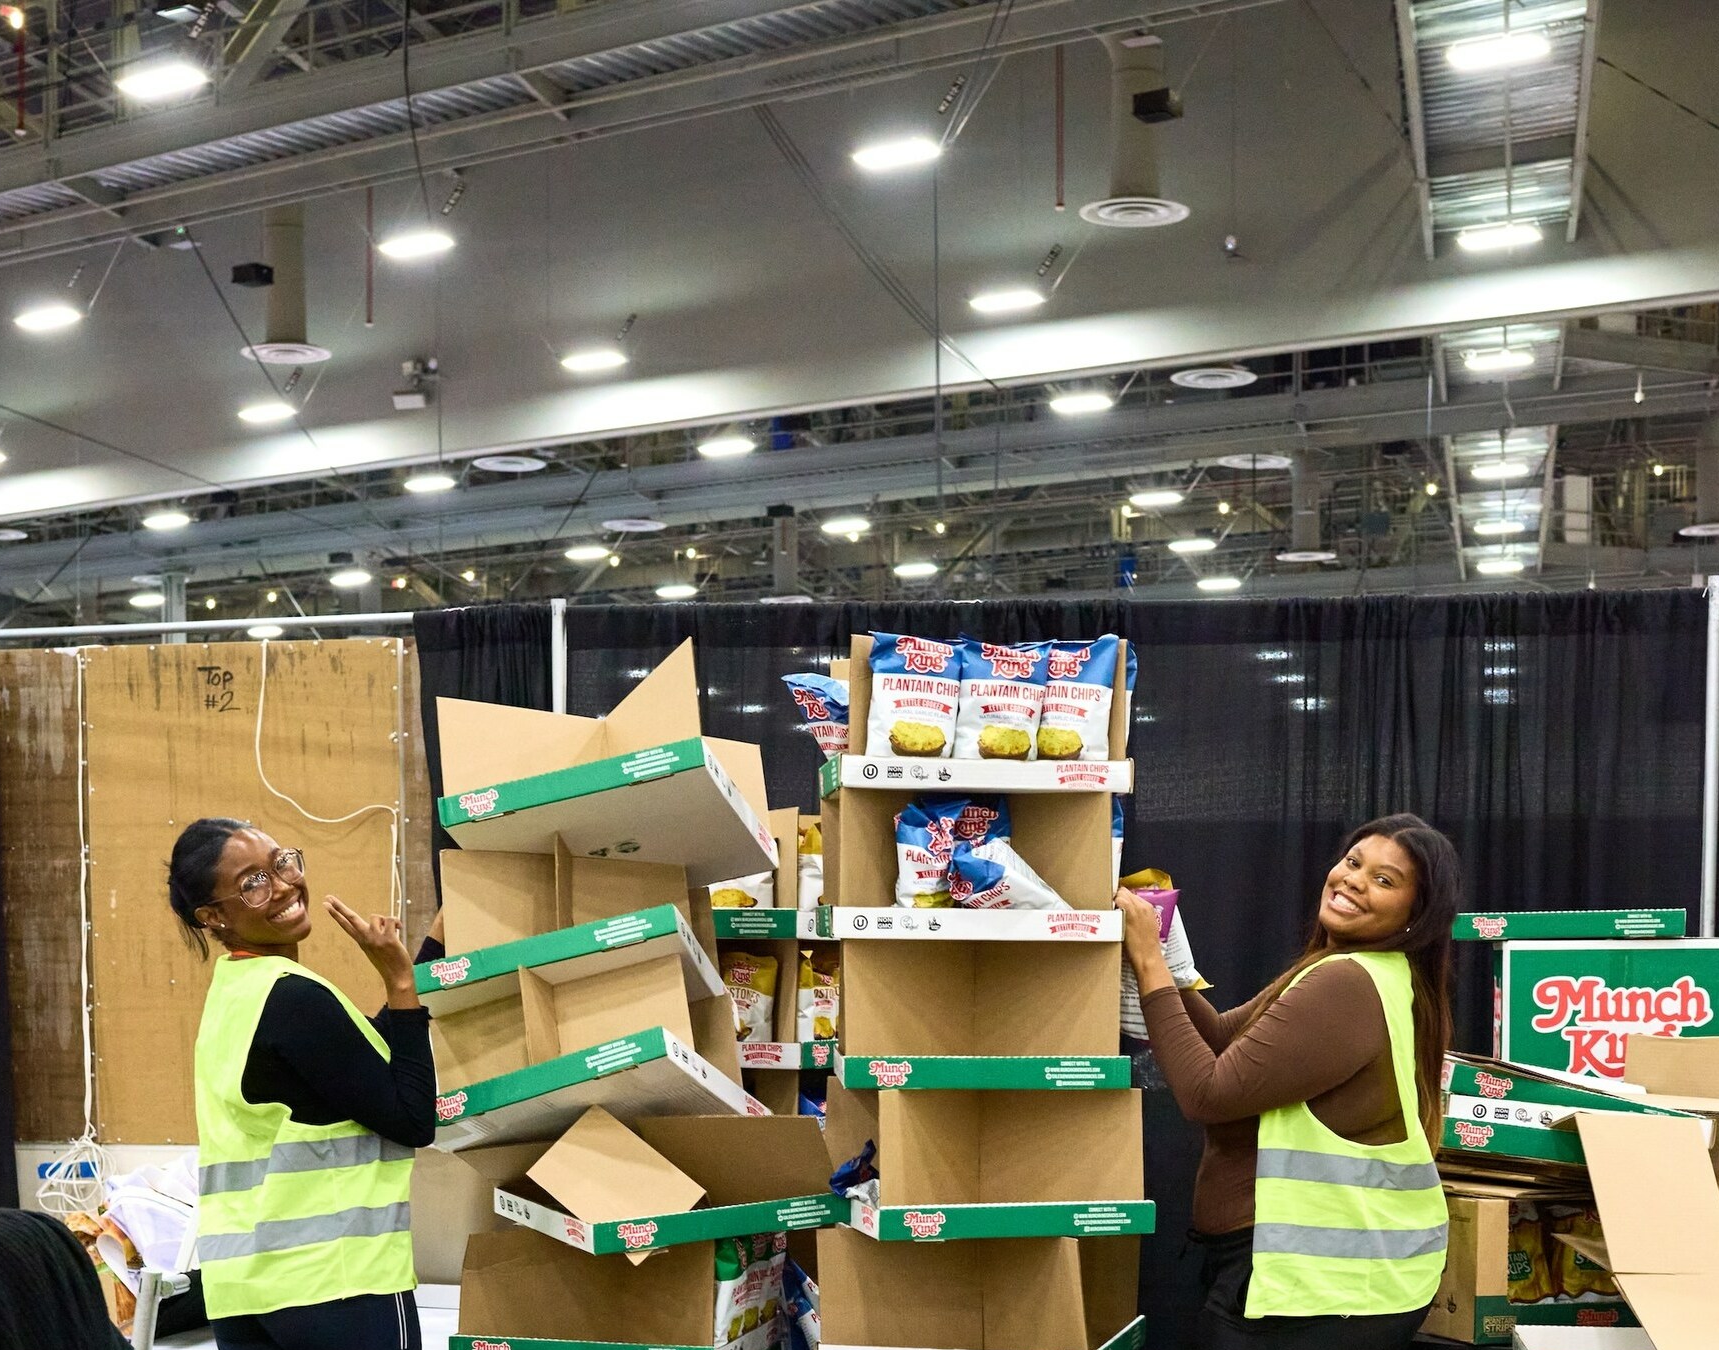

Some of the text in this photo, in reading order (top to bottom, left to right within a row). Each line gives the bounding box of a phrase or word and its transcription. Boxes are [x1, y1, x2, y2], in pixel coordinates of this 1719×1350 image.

[897, 637, 953, 657] Munch
[906, 652, 943, 673] King
[993, 658, 1032, 678] King
[883, 678, 960, 697] PLANTAIN CHIP
[971, 686, 1021, 699] PLANTAIN
[1073, 688, 1101, 702] CHIPS
[901, 698, 944, 712] KETTLE COOKED
[988, 704, 1031, 716] KETTLE COOKED
[1056, 764, 1109, 774] PLANTAIN CHIPS
[460, 790, 498, 807] Munch
[468, 800, 492, 815] King
[983, 882, 1010, 903] CHIPS
[1047, 914, 1101, 924] PLANTAIN CHIPS
[1472, 917, 1507, 929] Munch
[1479, 925, 1502, 937] King
[432, 958, 470, 975] Munch
[440, 969, 466, 984] King
[1534, 980, 1710, 1028] Munch
[870, 1062, 912, 1076] Munch
[878, 1072, 907, 1087] King
[1475, 1072, 1512, 1089] Munch
[1479, 1082, 1505, 1098] King
[439, 1102, 462, 1120] King
[1455, 1122, 1493, 1137] Munch
[1460, 1132, 1490, 1146] King
[904, 1212, 945, 1227] Munch
[619, 1222, 658, 1238] Munch
[911, 1223, 941, 1237] King
[625, 1232, 653, 1247] King
[1508, 1261, 1531, 1275] RIPS
